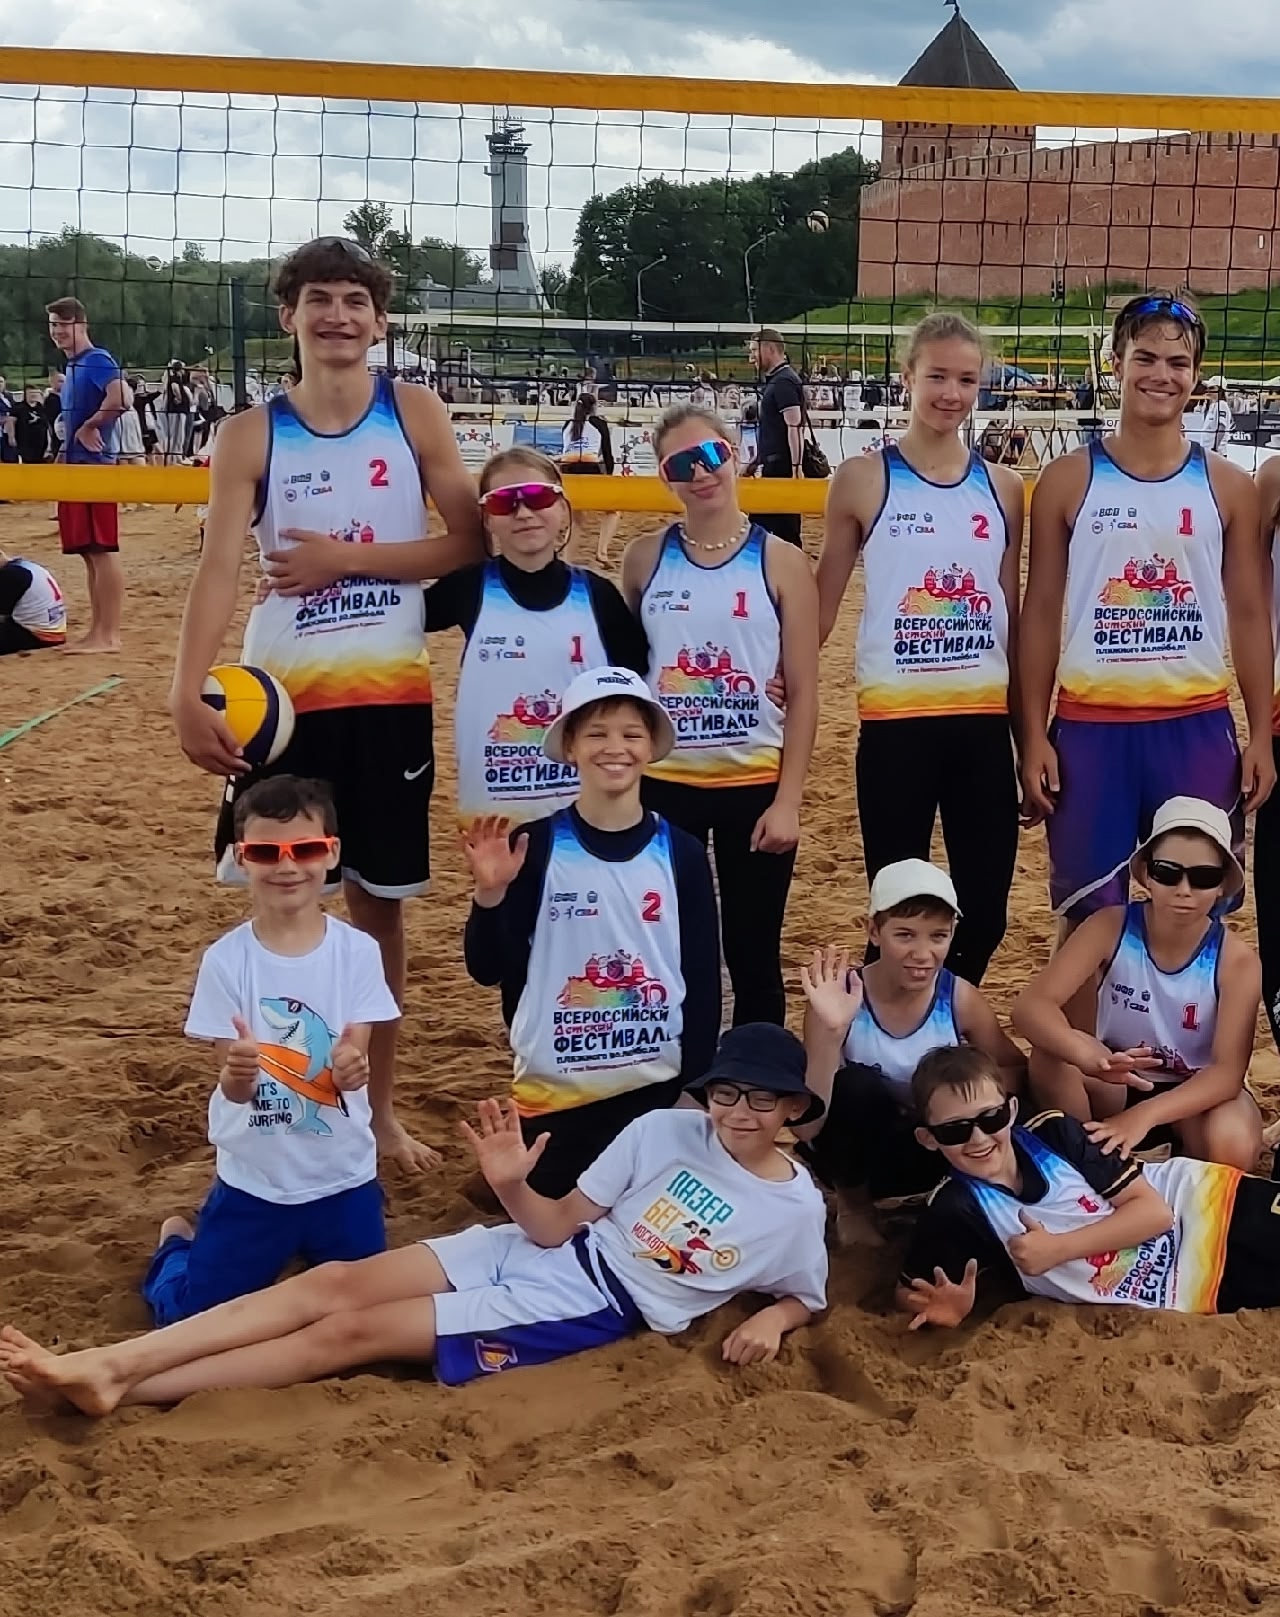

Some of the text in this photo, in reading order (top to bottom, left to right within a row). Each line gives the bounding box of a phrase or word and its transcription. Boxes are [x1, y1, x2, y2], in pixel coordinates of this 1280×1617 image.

[1228, 431, 1251, 441] rdin
[369, 459, 389, 487] 2
[971, 514, 989, 539] 2
[1179, 508, 1193, 535] 1
[732, 592, 749, 618] 1
[894, 634, 995, 655] ФЕСТИВАЛЬ
[1093, 625, 1204, 646] ФЕСТИВАЛЬ
[571, 635, 584, 663] 1
[485, 763, 580, 783] ФЕСТИВА
[641, 892, 661, 921] 2
[1183, 1004, 1199, 1030] 1
[254, 1097, 290, 1111] ME TO
[248, 1112, 293, 1127] SURFING
[667, 1170, 735, 1225] ЛАЗЕР
[642, 1197, 687, 1233] БЕГ
